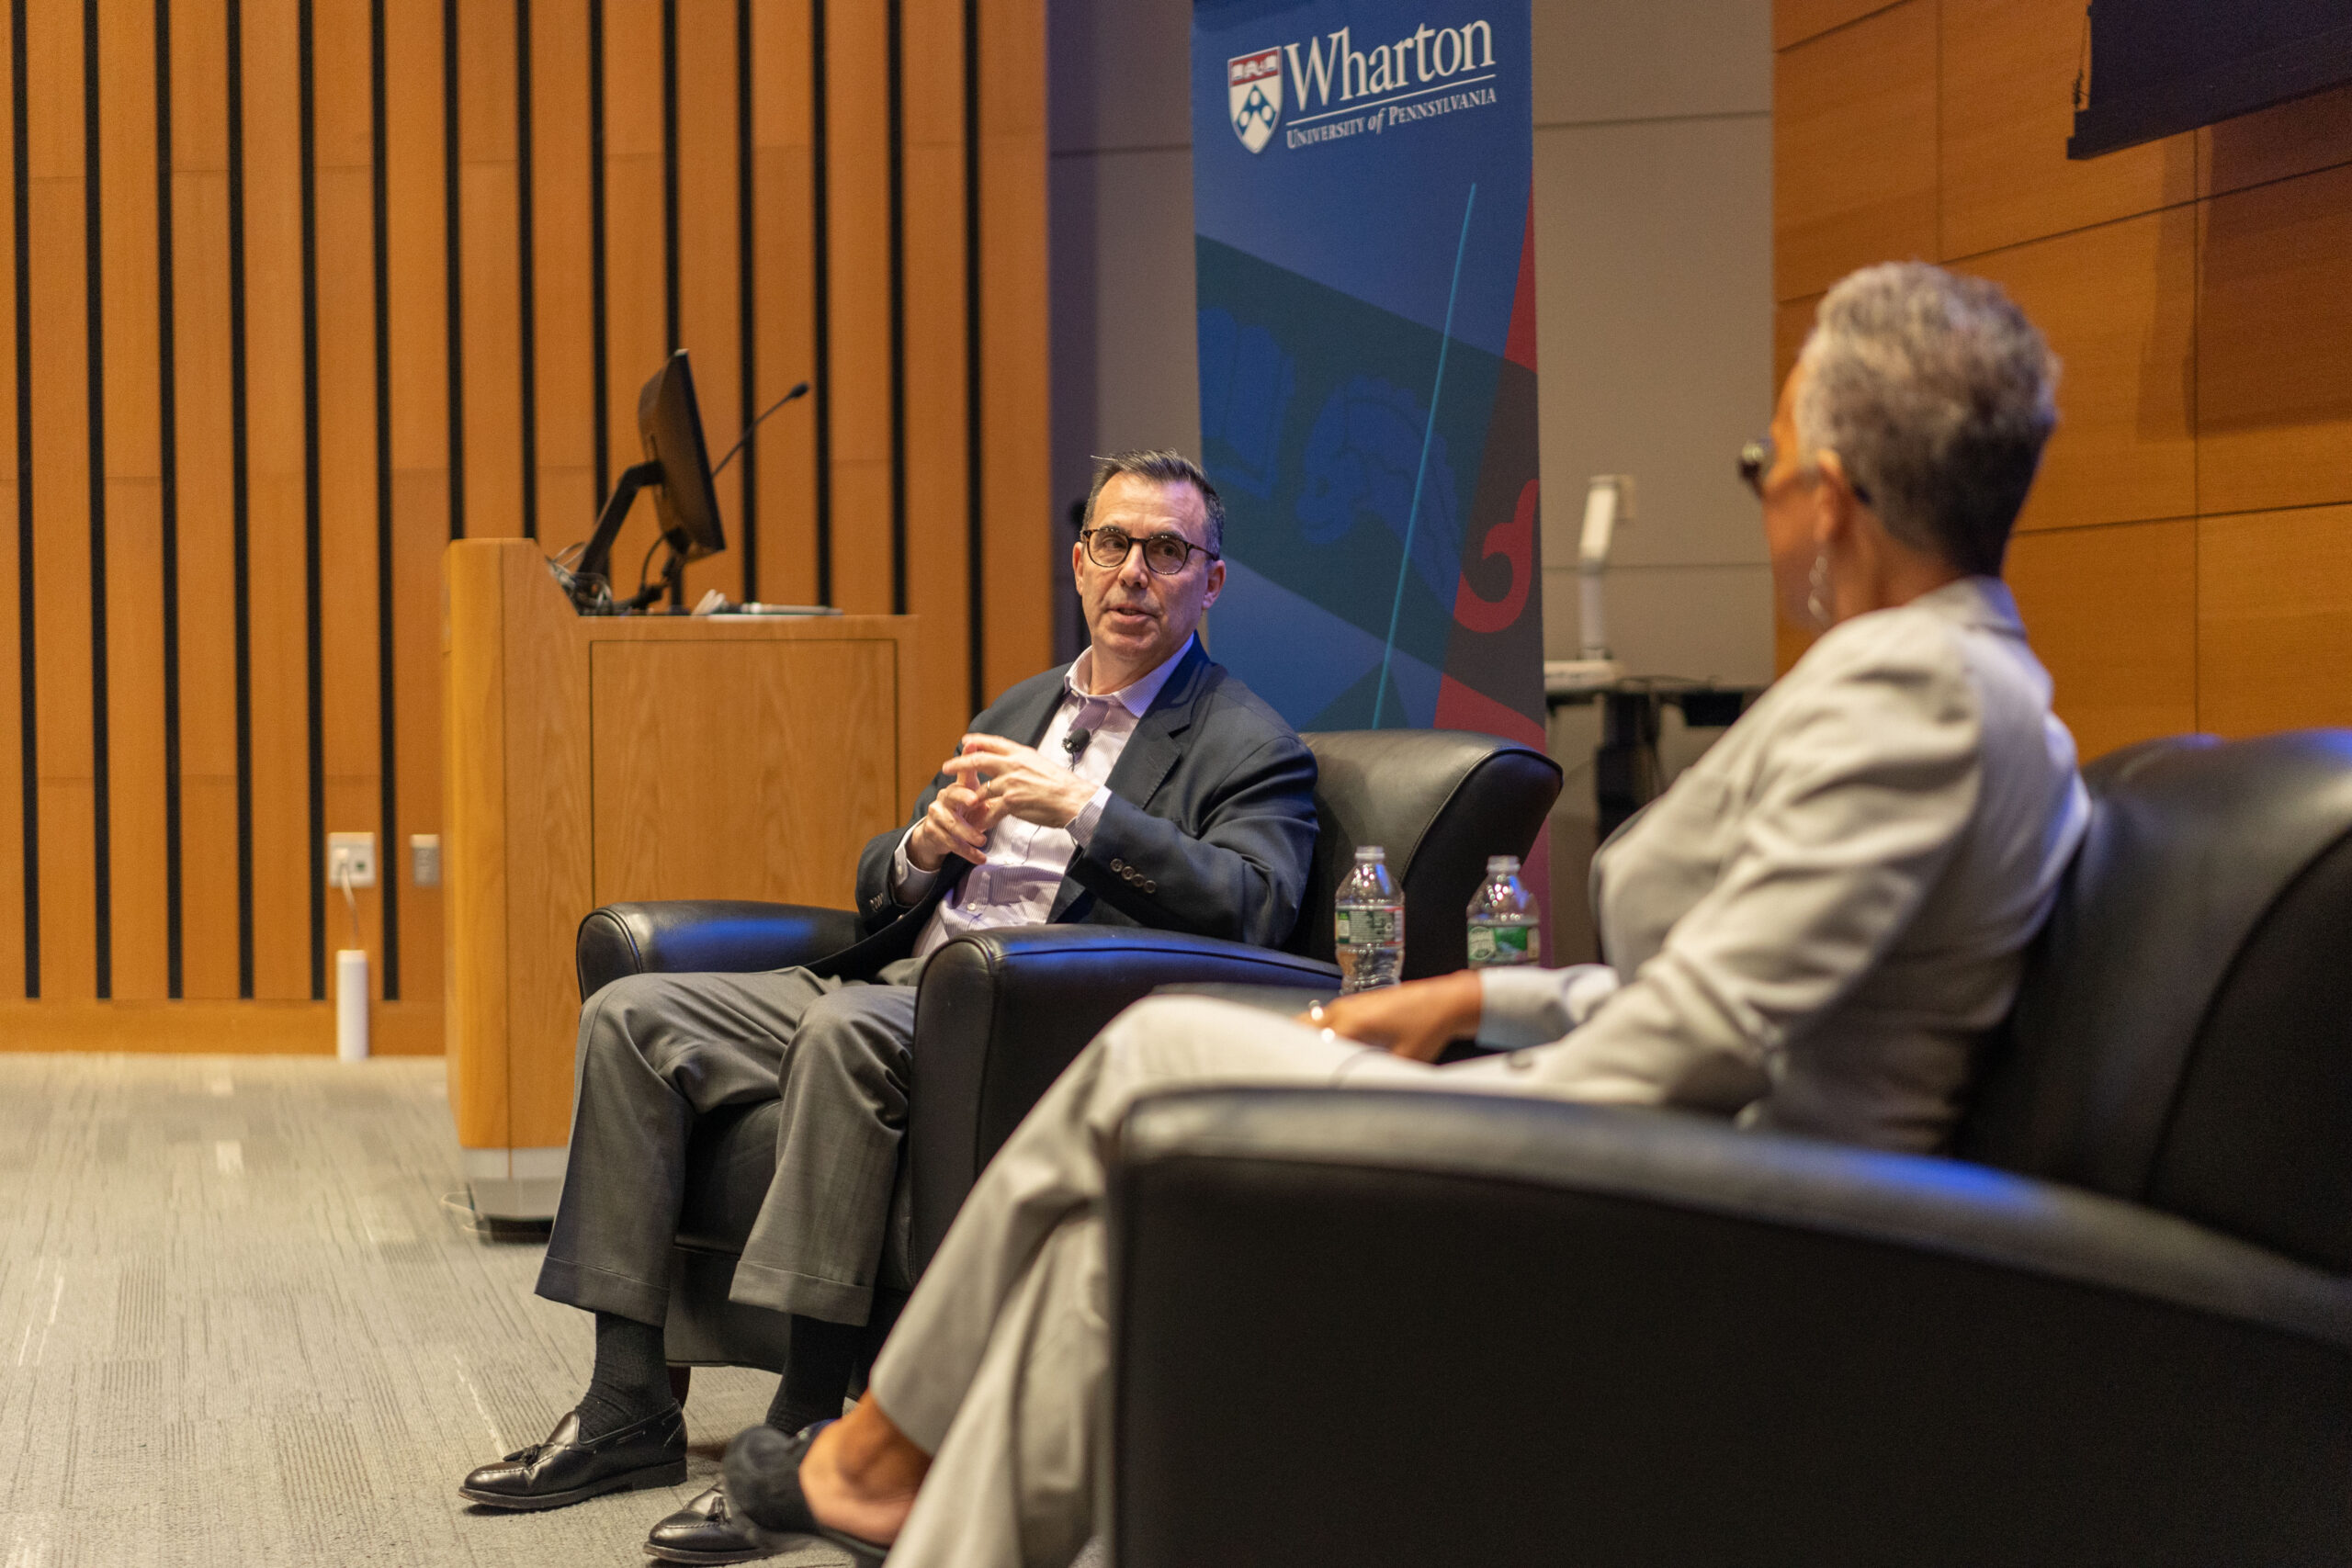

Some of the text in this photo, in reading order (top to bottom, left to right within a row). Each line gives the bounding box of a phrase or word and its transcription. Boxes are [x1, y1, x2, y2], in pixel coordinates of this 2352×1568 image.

[1284, 19, 1497, 111] Wharton
[1287, 87, 1497, 149] UNIVERSITY of PENNSYLVANIA
